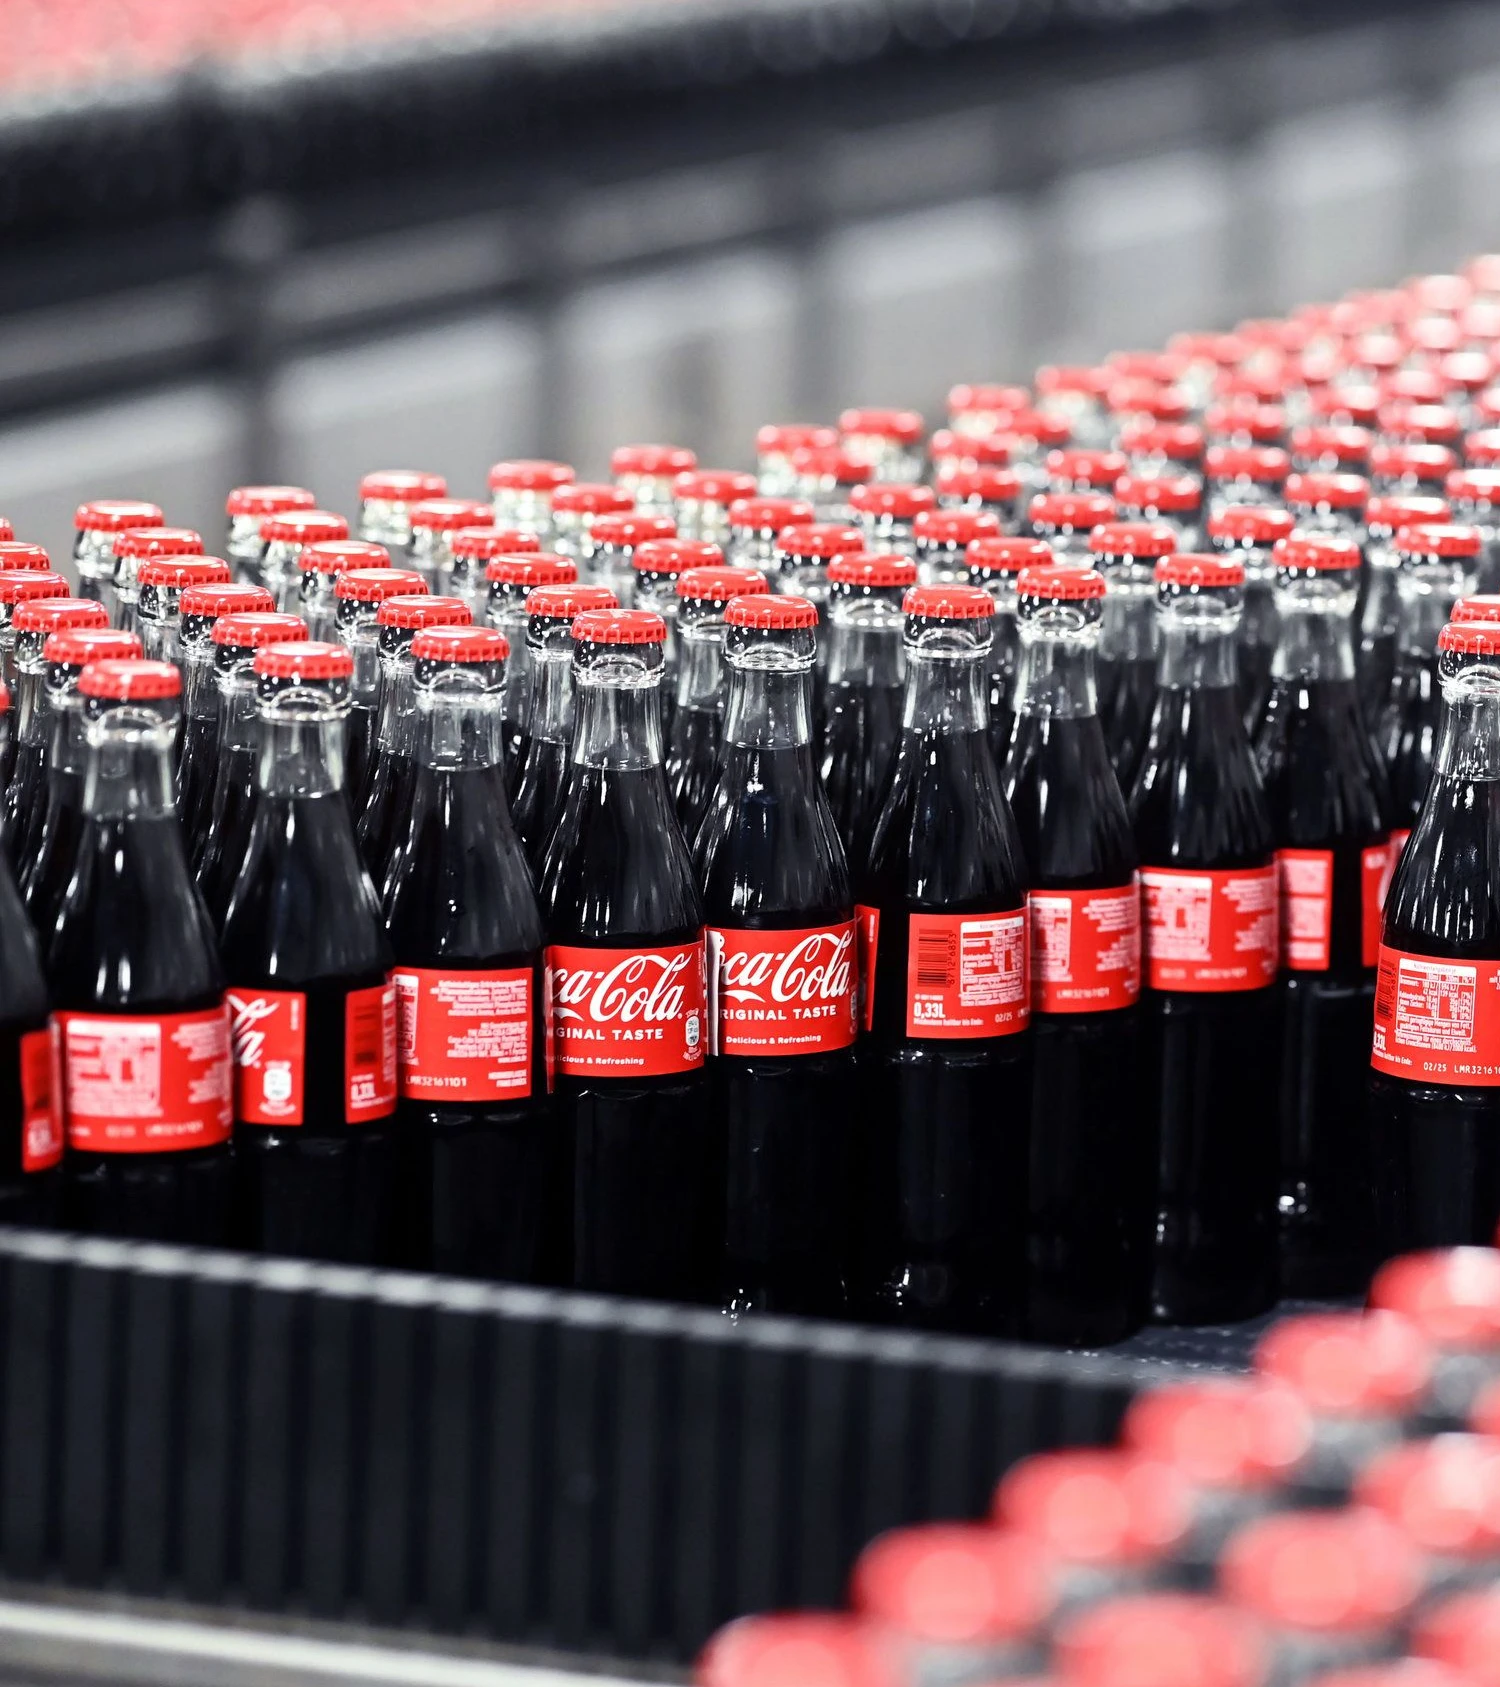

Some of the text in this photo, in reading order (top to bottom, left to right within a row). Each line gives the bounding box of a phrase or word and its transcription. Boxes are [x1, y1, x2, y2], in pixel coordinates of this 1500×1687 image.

[793, 1004, 836, 1019] TASTE
[913, 1001, 946, 1019] 0,33L
[612, 1028, 664, 1041] TASTE
[726, 1035, 767, 1045] Delicious
[777, 1034, 822, 1045] Refreshing
[595, 1056, 645, 1066] Refreshing
[1423, 1061, 1447, 1073] 02/25
